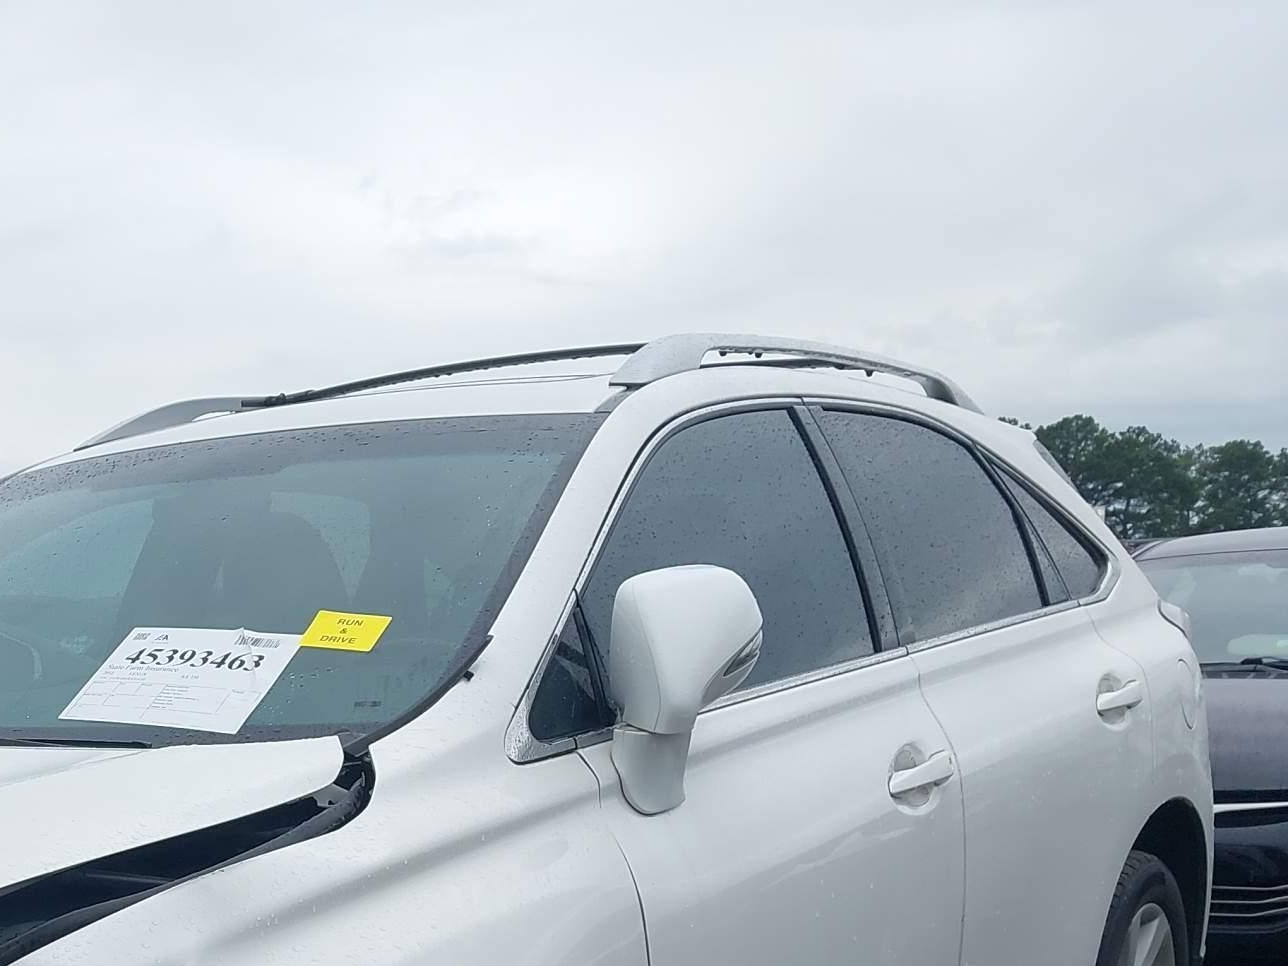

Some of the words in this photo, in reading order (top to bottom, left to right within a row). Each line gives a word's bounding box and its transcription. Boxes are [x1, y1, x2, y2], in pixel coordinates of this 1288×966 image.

[337, 618, 364, 627] RUN
[320, 635, 357, 645] DRIVE
[125, 648, 265, 672] 45393463
